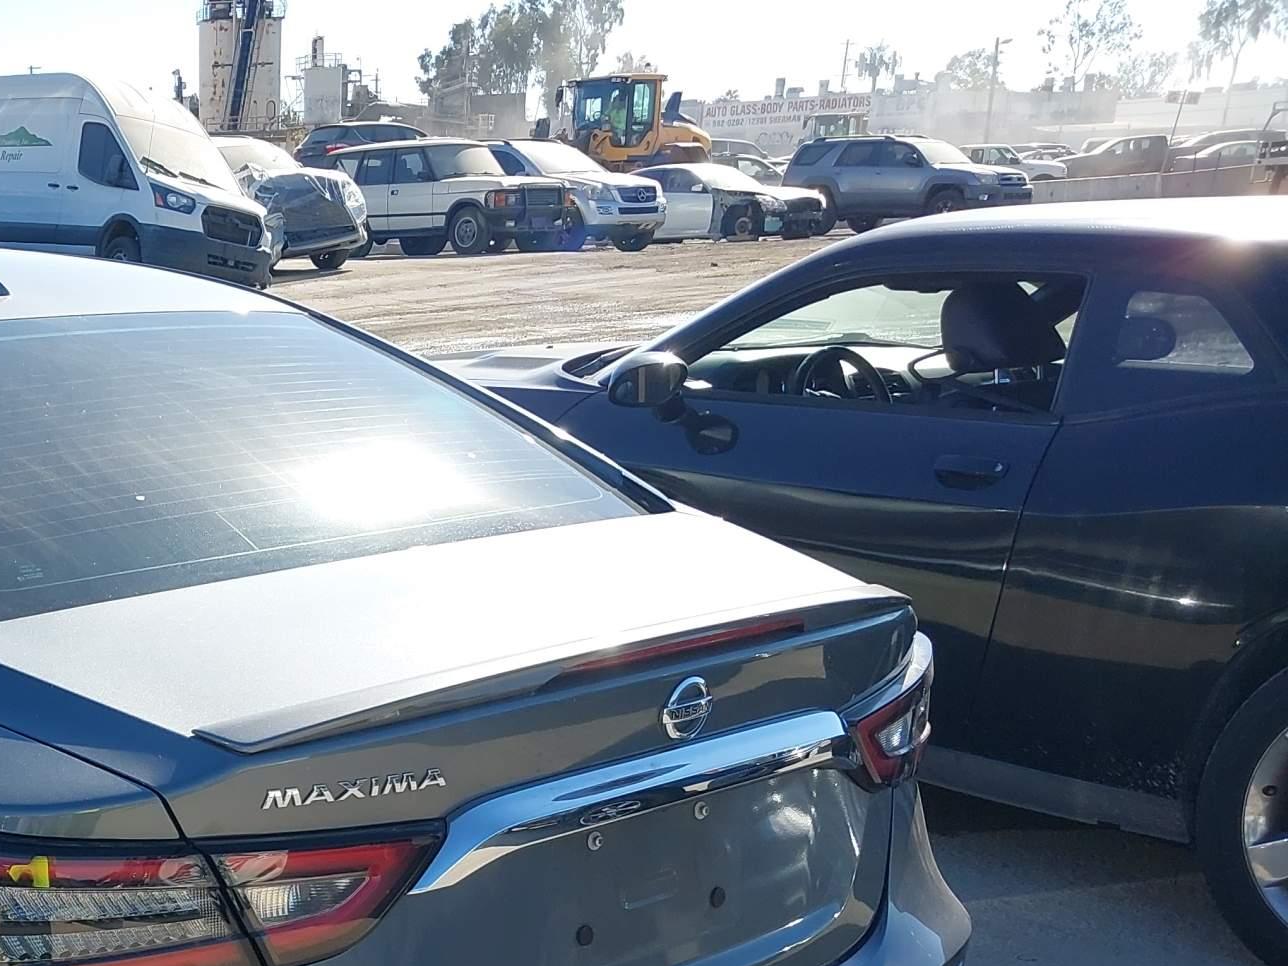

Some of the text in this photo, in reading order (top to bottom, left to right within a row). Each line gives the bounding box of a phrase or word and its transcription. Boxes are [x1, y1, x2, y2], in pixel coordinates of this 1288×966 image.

[705, 105, 728, 118] AUTO
[0, 149, 24, 164] Repair
[671, 702, 710, 720] NISSAN
[261, 768, 447, 810] MAXIMA
